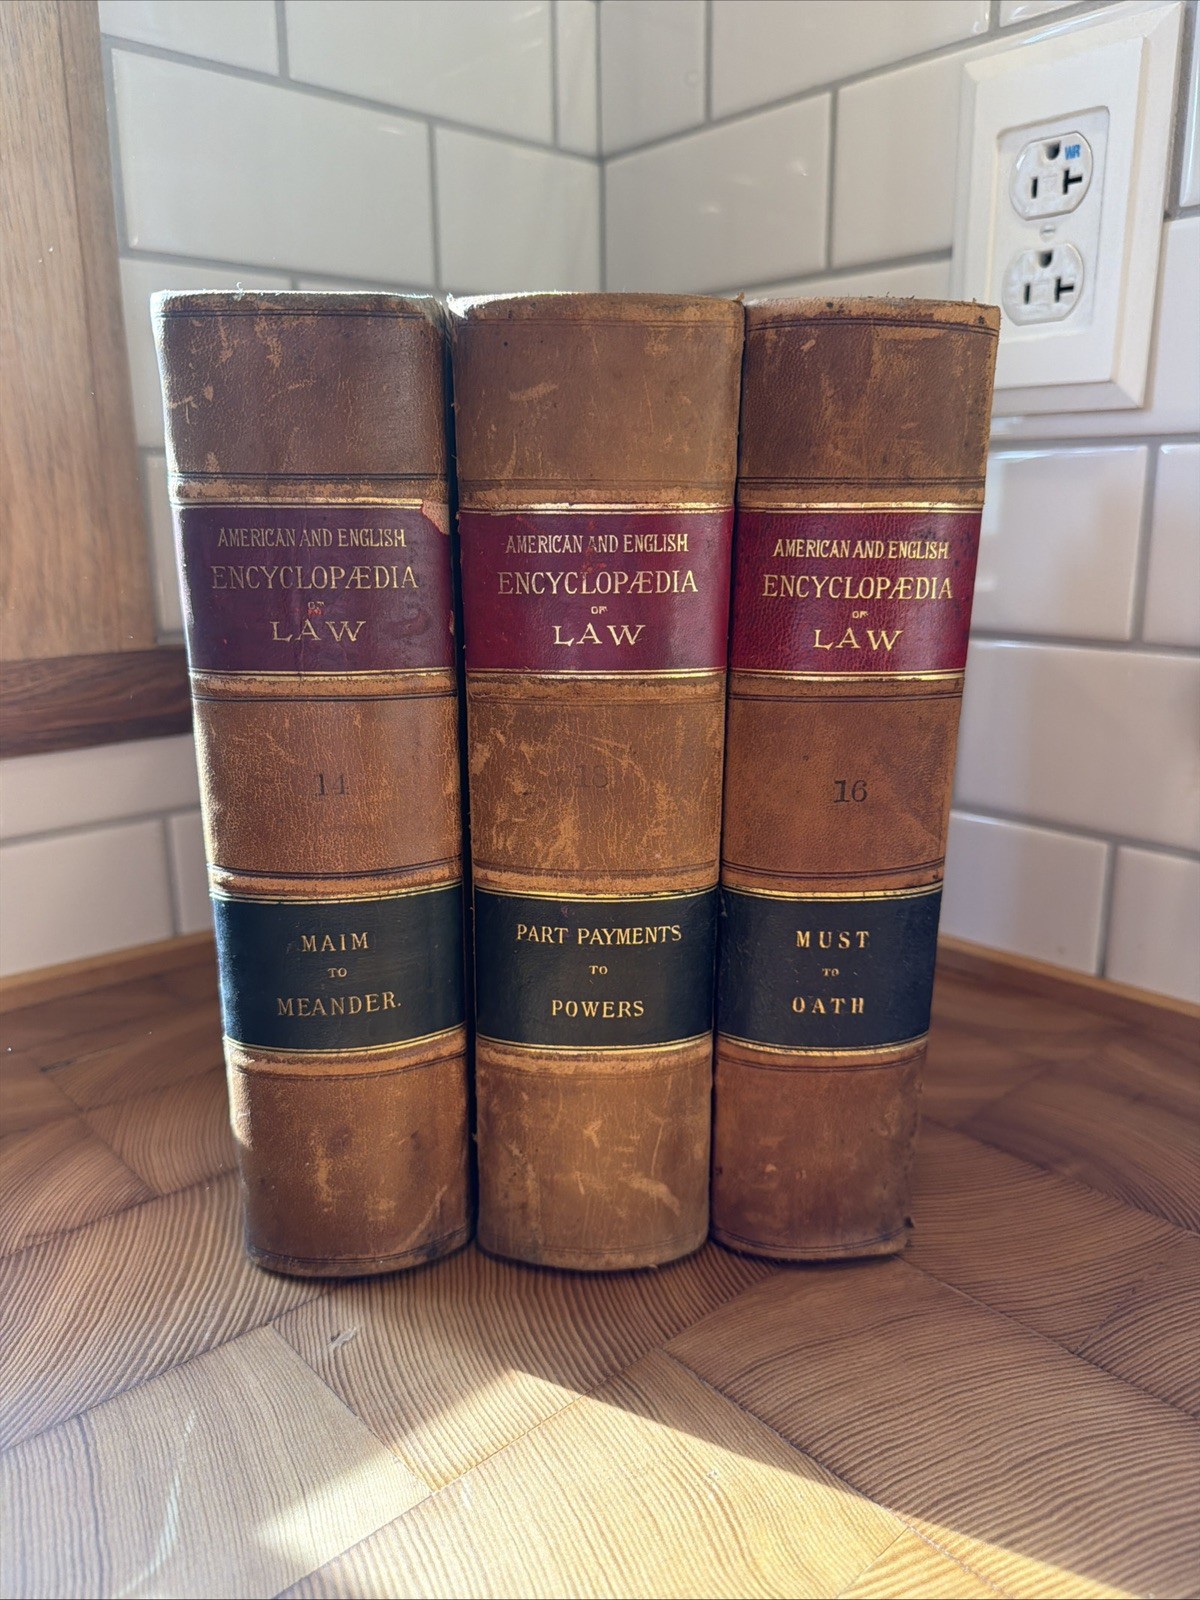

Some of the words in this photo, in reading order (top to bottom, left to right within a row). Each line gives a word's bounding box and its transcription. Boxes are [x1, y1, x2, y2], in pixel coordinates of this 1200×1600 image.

[1064, 144, 1081, 160] WR
[217, 527, 296, 547] AMERICAN
[299, 528, 332, 547] AND
[337, 528, 407, 547] ENGLISH
[505, 534, 583, 554] AMERICAN
[588, 534, 619, 554] AND
[623, 534, 689, 553] ENGLISH
[772, 538, 851, 558] AMERICAN
[852, 540, 884, 559] AND
[888, 541, 949, 560] ENGLISH
[210, 565, 419, 590] ENCYCLOPÆDIA
[497, 570, 699, 596] ENCYCLOPÆDIA
[761, 574, 953, 600] ENCYCLOPÆDIA
[590, 605, 608, 615] OF
[851, 610, 869, 619] OF
[269, 619, 367, 643] LAW
[552, 622, 646, 647] LAW
[812, 627, 904, 652] LAW
[833, 779, 868, 803] 16
[300, 931, 370, 952] MAIM
[516, 923, 569, 944] PART
[577, 925, 683, 946] PAYMENTS
[796, 930, 870, 950] MUST
[327, 967, 348, 978] TO
[588, 965, 608, 975] TO
[822, 967, 840, 977] TO
[277, 990, 402, 1017] MEANDER.
[551, 999, 645, 1019] POWERS
[792, 996, 865, 1015] OATH
